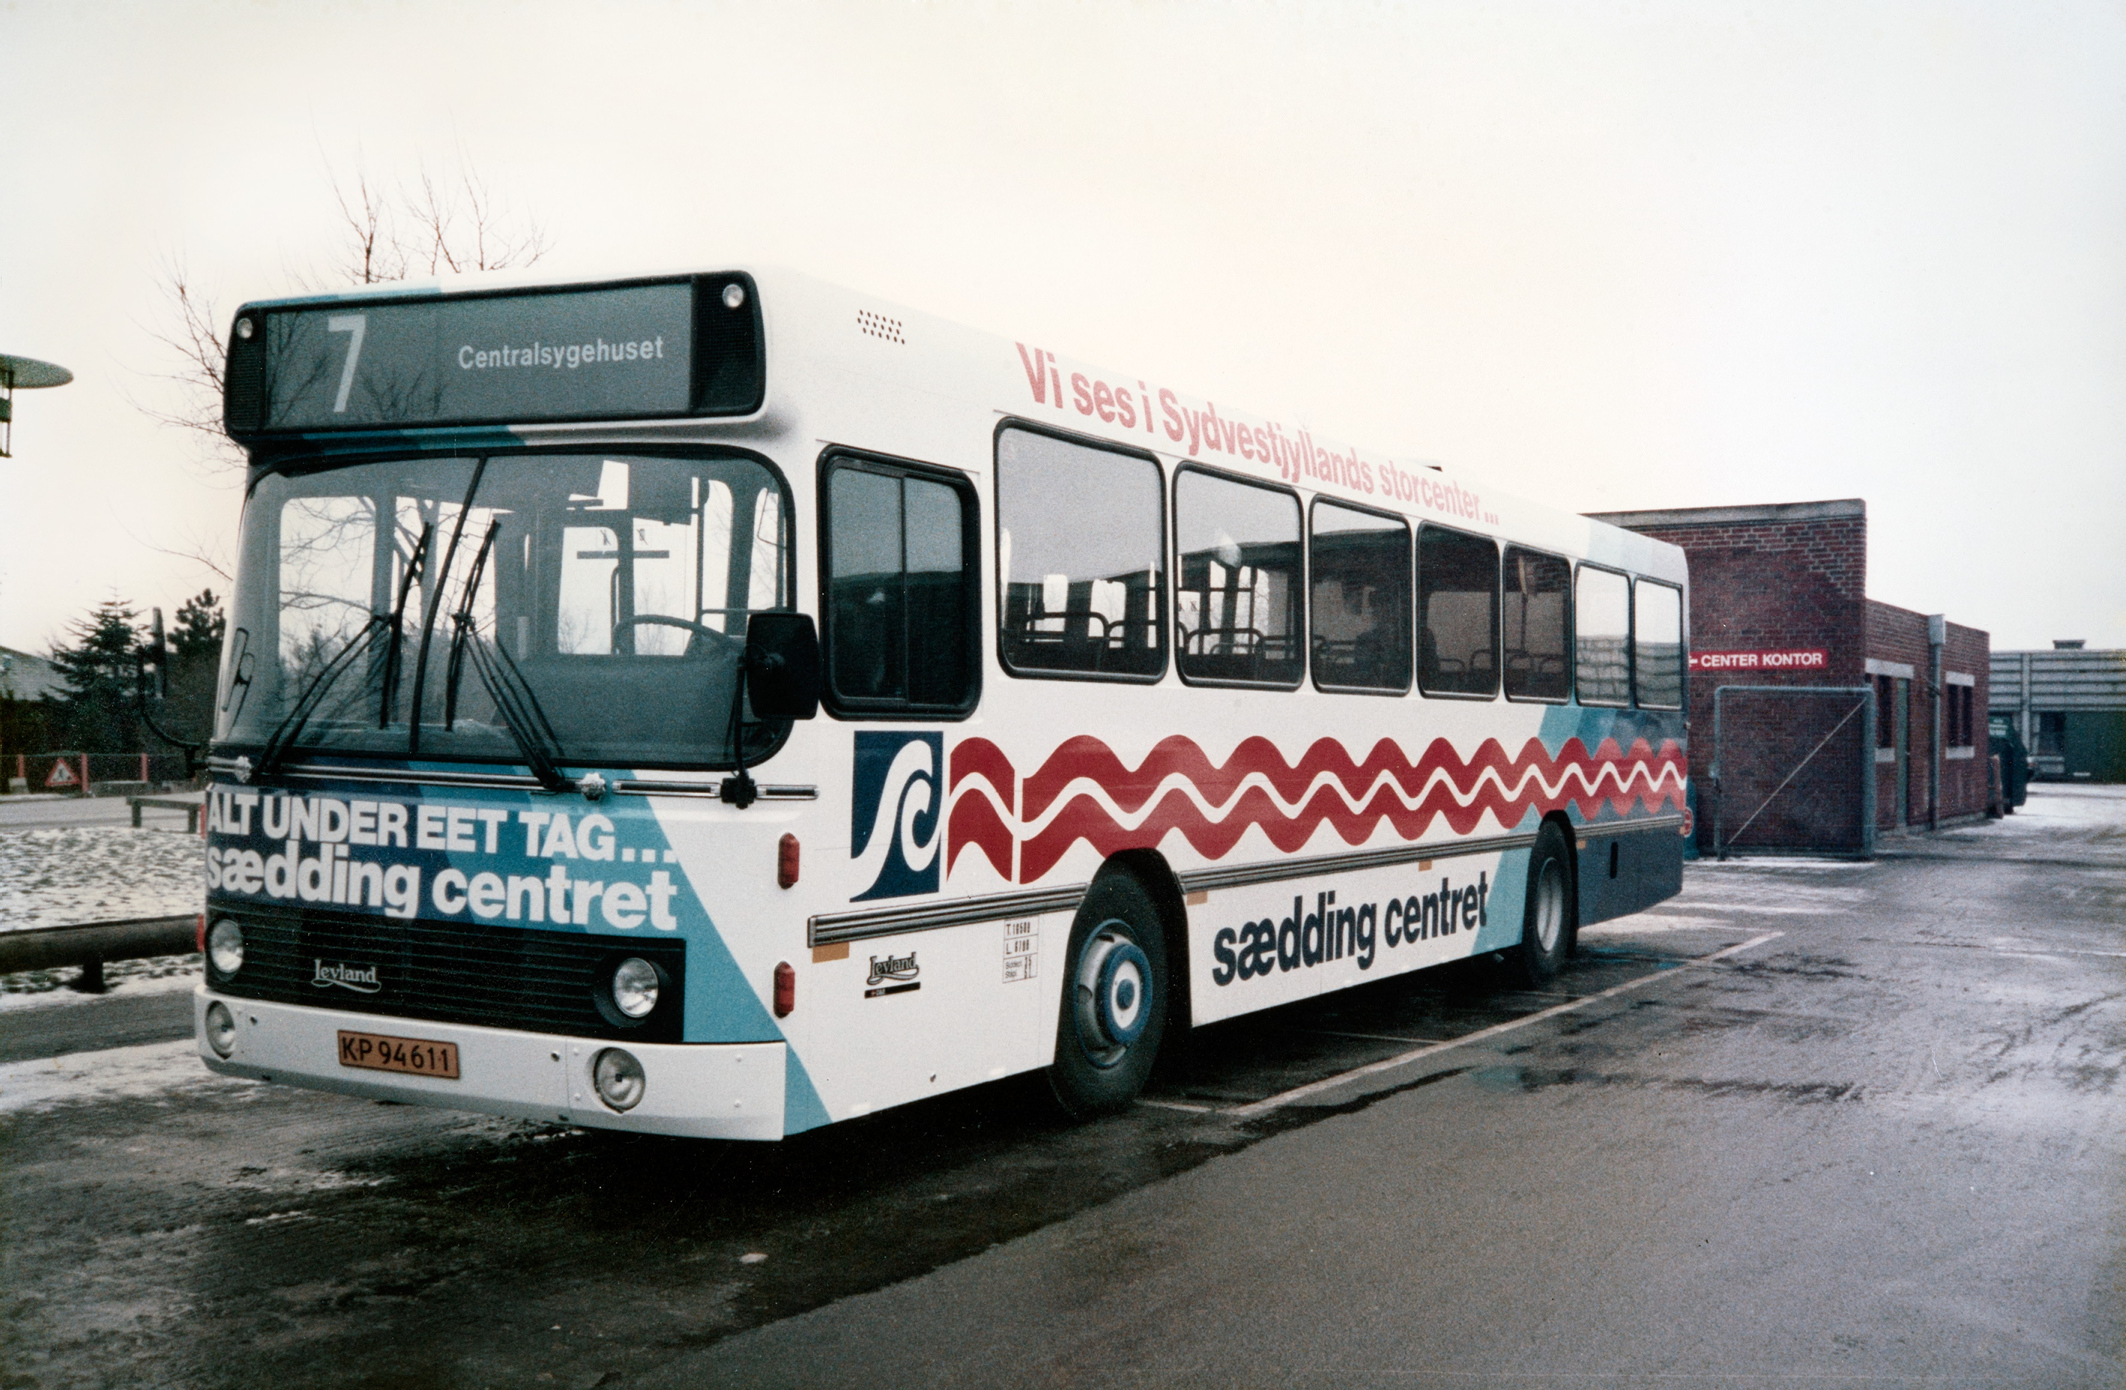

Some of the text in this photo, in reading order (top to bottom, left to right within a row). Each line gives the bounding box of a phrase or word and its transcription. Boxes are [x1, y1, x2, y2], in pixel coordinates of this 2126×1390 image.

[327, 315, 366, 414] 7
[458, 335, 664, 370] Centralsygehuset
[1015, 342, 1063, 409] Vi
[1070, 371, 1137, 429] ses
[1138, 380, 1154, 433] i
[1158, 387, 1375, 494] Sydvestjyllands
[1701, 652, 1823, 668] CENTER KONTOR
[207, 791, 259, 835] ALT
[263, 795, 408, 849] UNDER
[417, 804, 508, 854] EET
[207, 840, 678, 931] sædding centret
[1212, 871, 1489, 987] sædding centret
[311, 959, 382, 993] Leyland
[866, 951, 919, 985] Leyland
[341, 1036, 448, 1071] KP 94611
